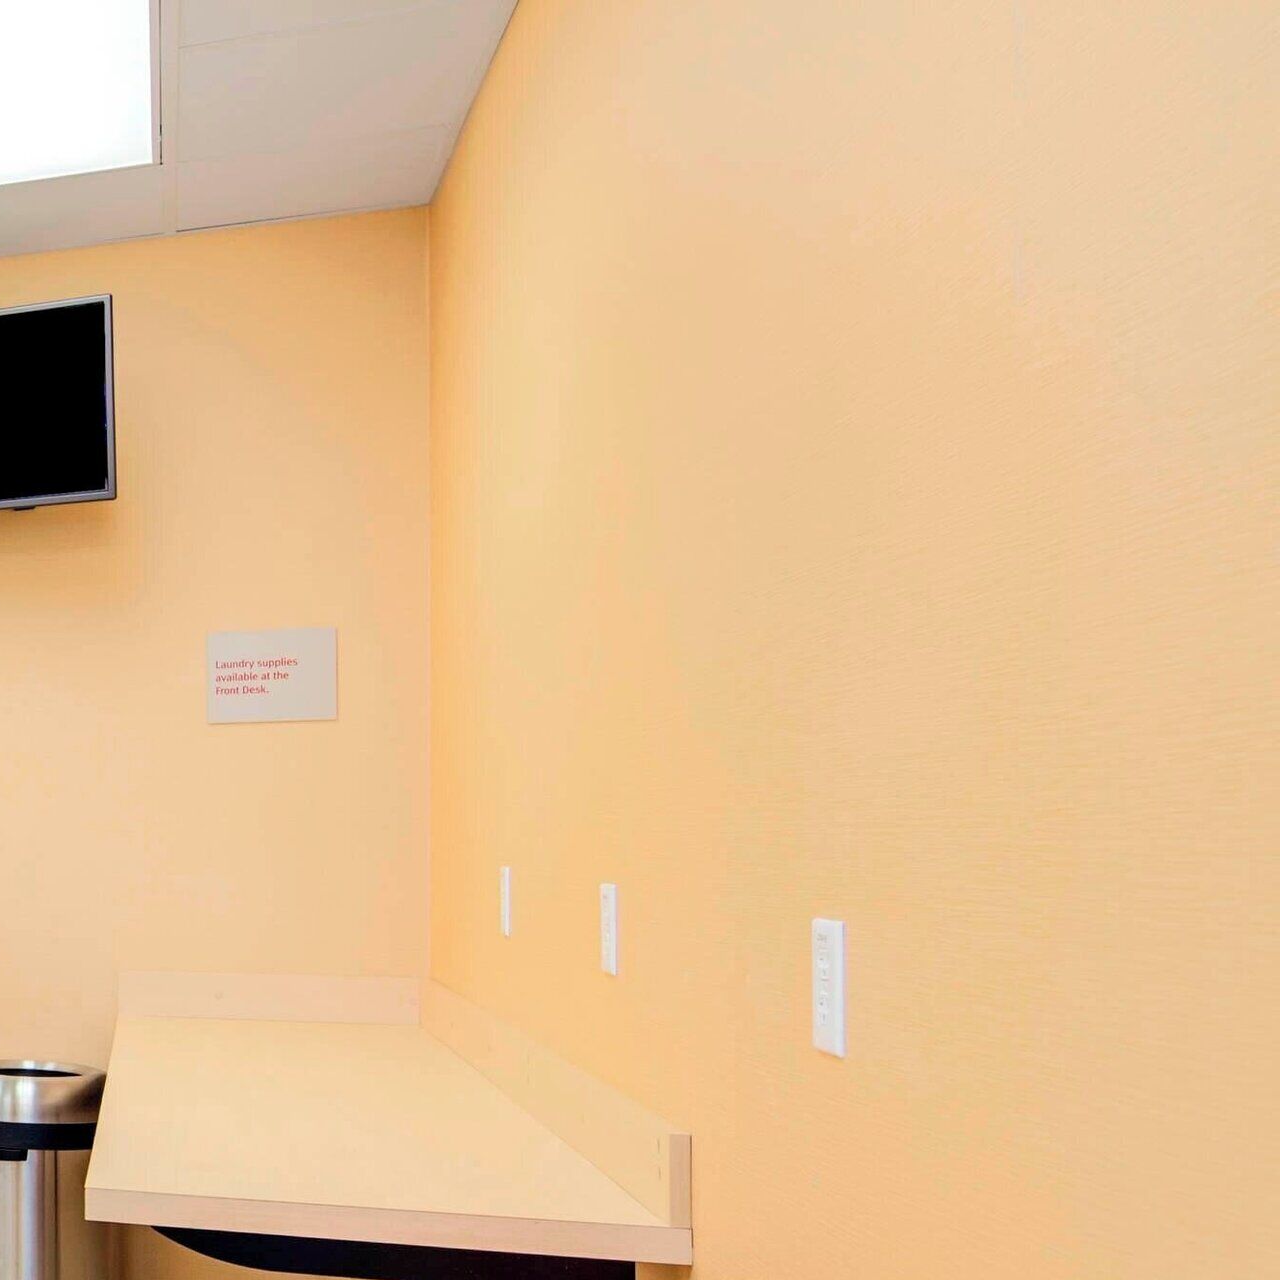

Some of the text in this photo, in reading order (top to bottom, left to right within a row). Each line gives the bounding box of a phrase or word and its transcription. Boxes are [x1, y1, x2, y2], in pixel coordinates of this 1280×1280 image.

[215, 657, 298, 669] Laundry supplies
[215, 671, 289, 682] available at the
[215, 684, 269, 695] Front Desk.
